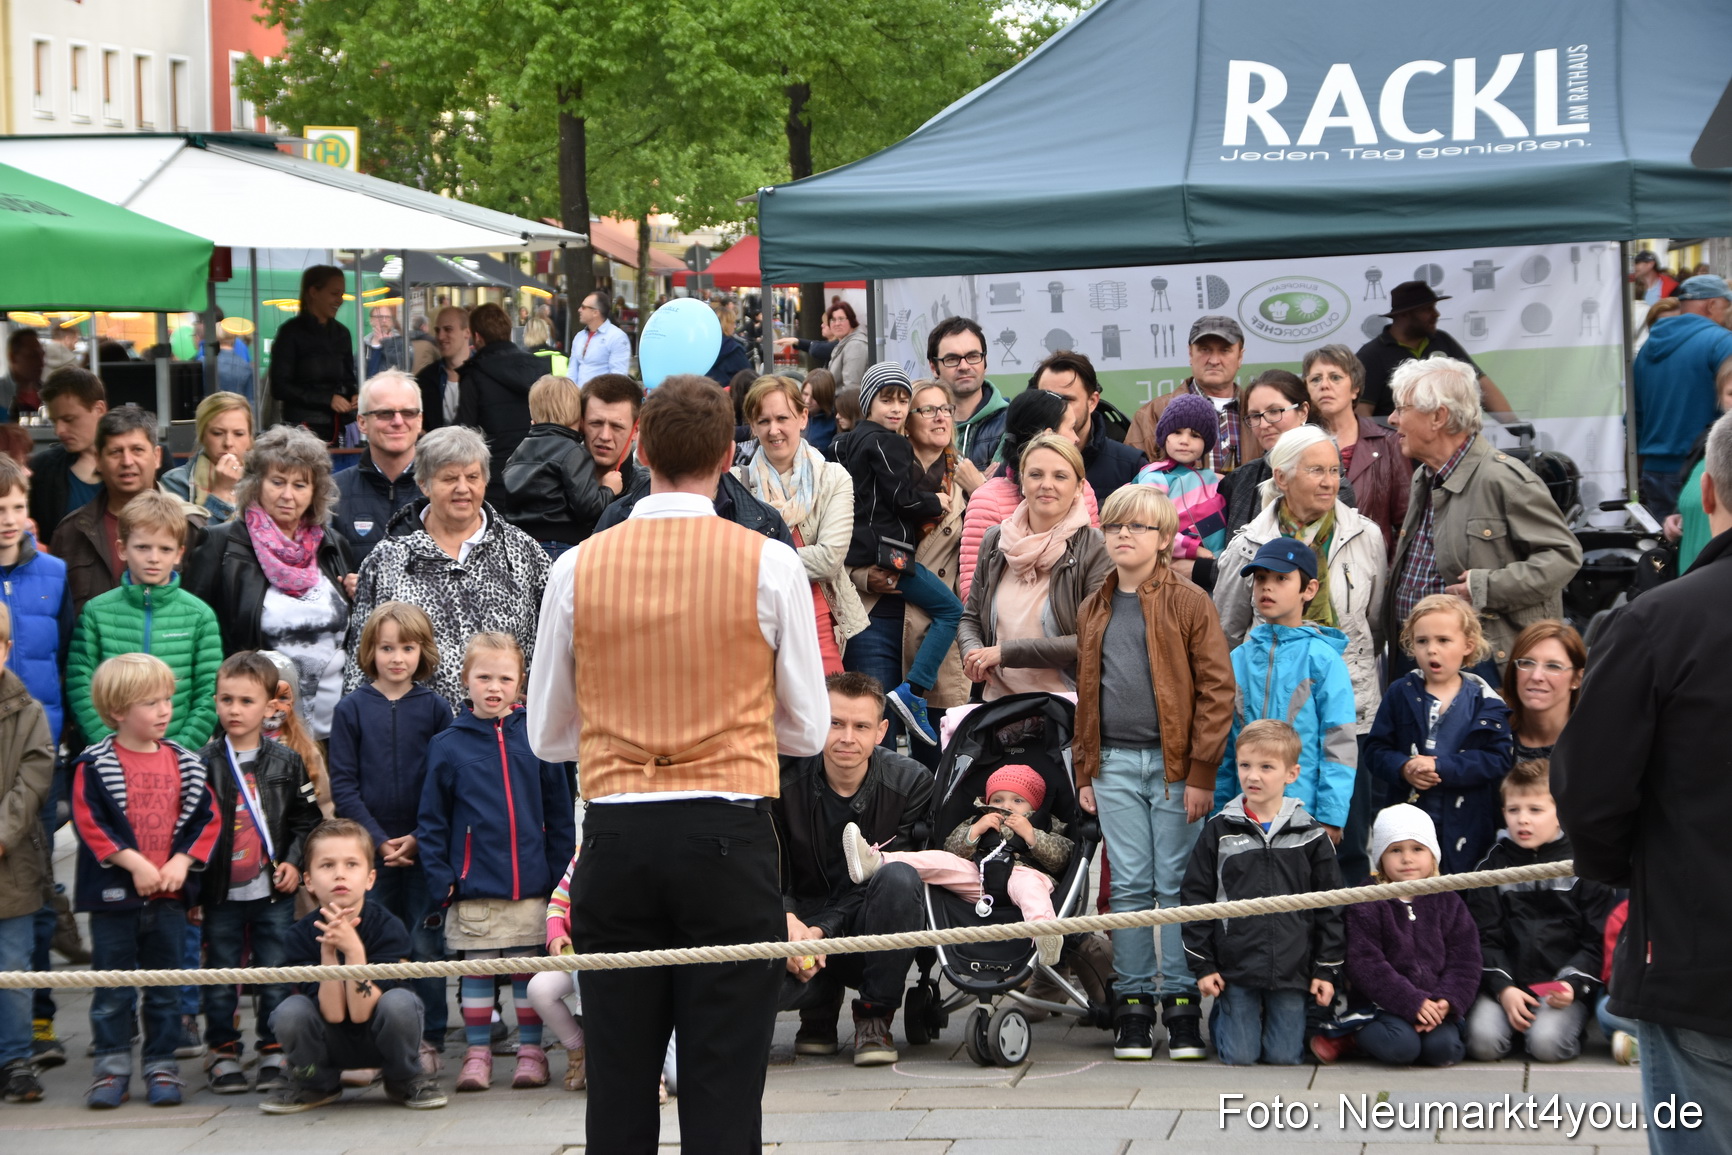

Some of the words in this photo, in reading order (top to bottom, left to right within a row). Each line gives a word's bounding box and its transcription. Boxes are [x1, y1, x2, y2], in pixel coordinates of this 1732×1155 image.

[1567, 44, 1589, 101] RATHAUS
[1222, 48, 1590, 146] RACKL
[1568, 105, 1589, 120] AM
[1220, 148, 1330, 162] Jeden
[1341, 147, 1406, 161] Tag
[1416, 138, 1593, 160] genießen.
[127, 772, 173, 790] KEEP
[970, 961, 1012, 973] Quinny
